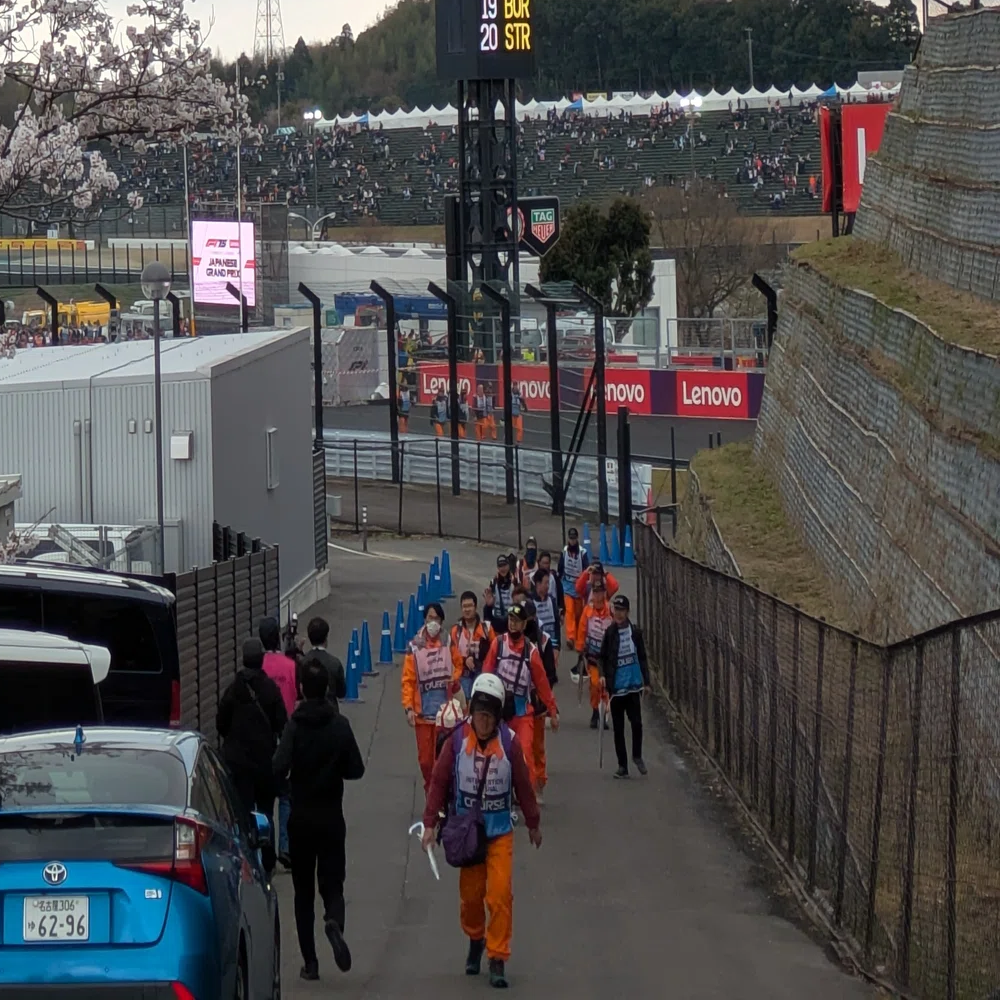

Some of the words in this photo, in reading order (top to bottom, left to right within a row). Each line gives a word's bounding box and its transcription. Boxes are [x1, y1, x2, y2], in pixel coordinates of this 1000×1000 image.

[480, 23, 498, 51] 20
[505, 23, 531, 50] STR
[533, 211, 553, 222] TAG
[209, 258, 237, 268] JAPANESE
[205, 268, 226, 277] GRAND
[682, 380, 742, 407] Lenovo
[38, 914, 86, 937] 62-96
